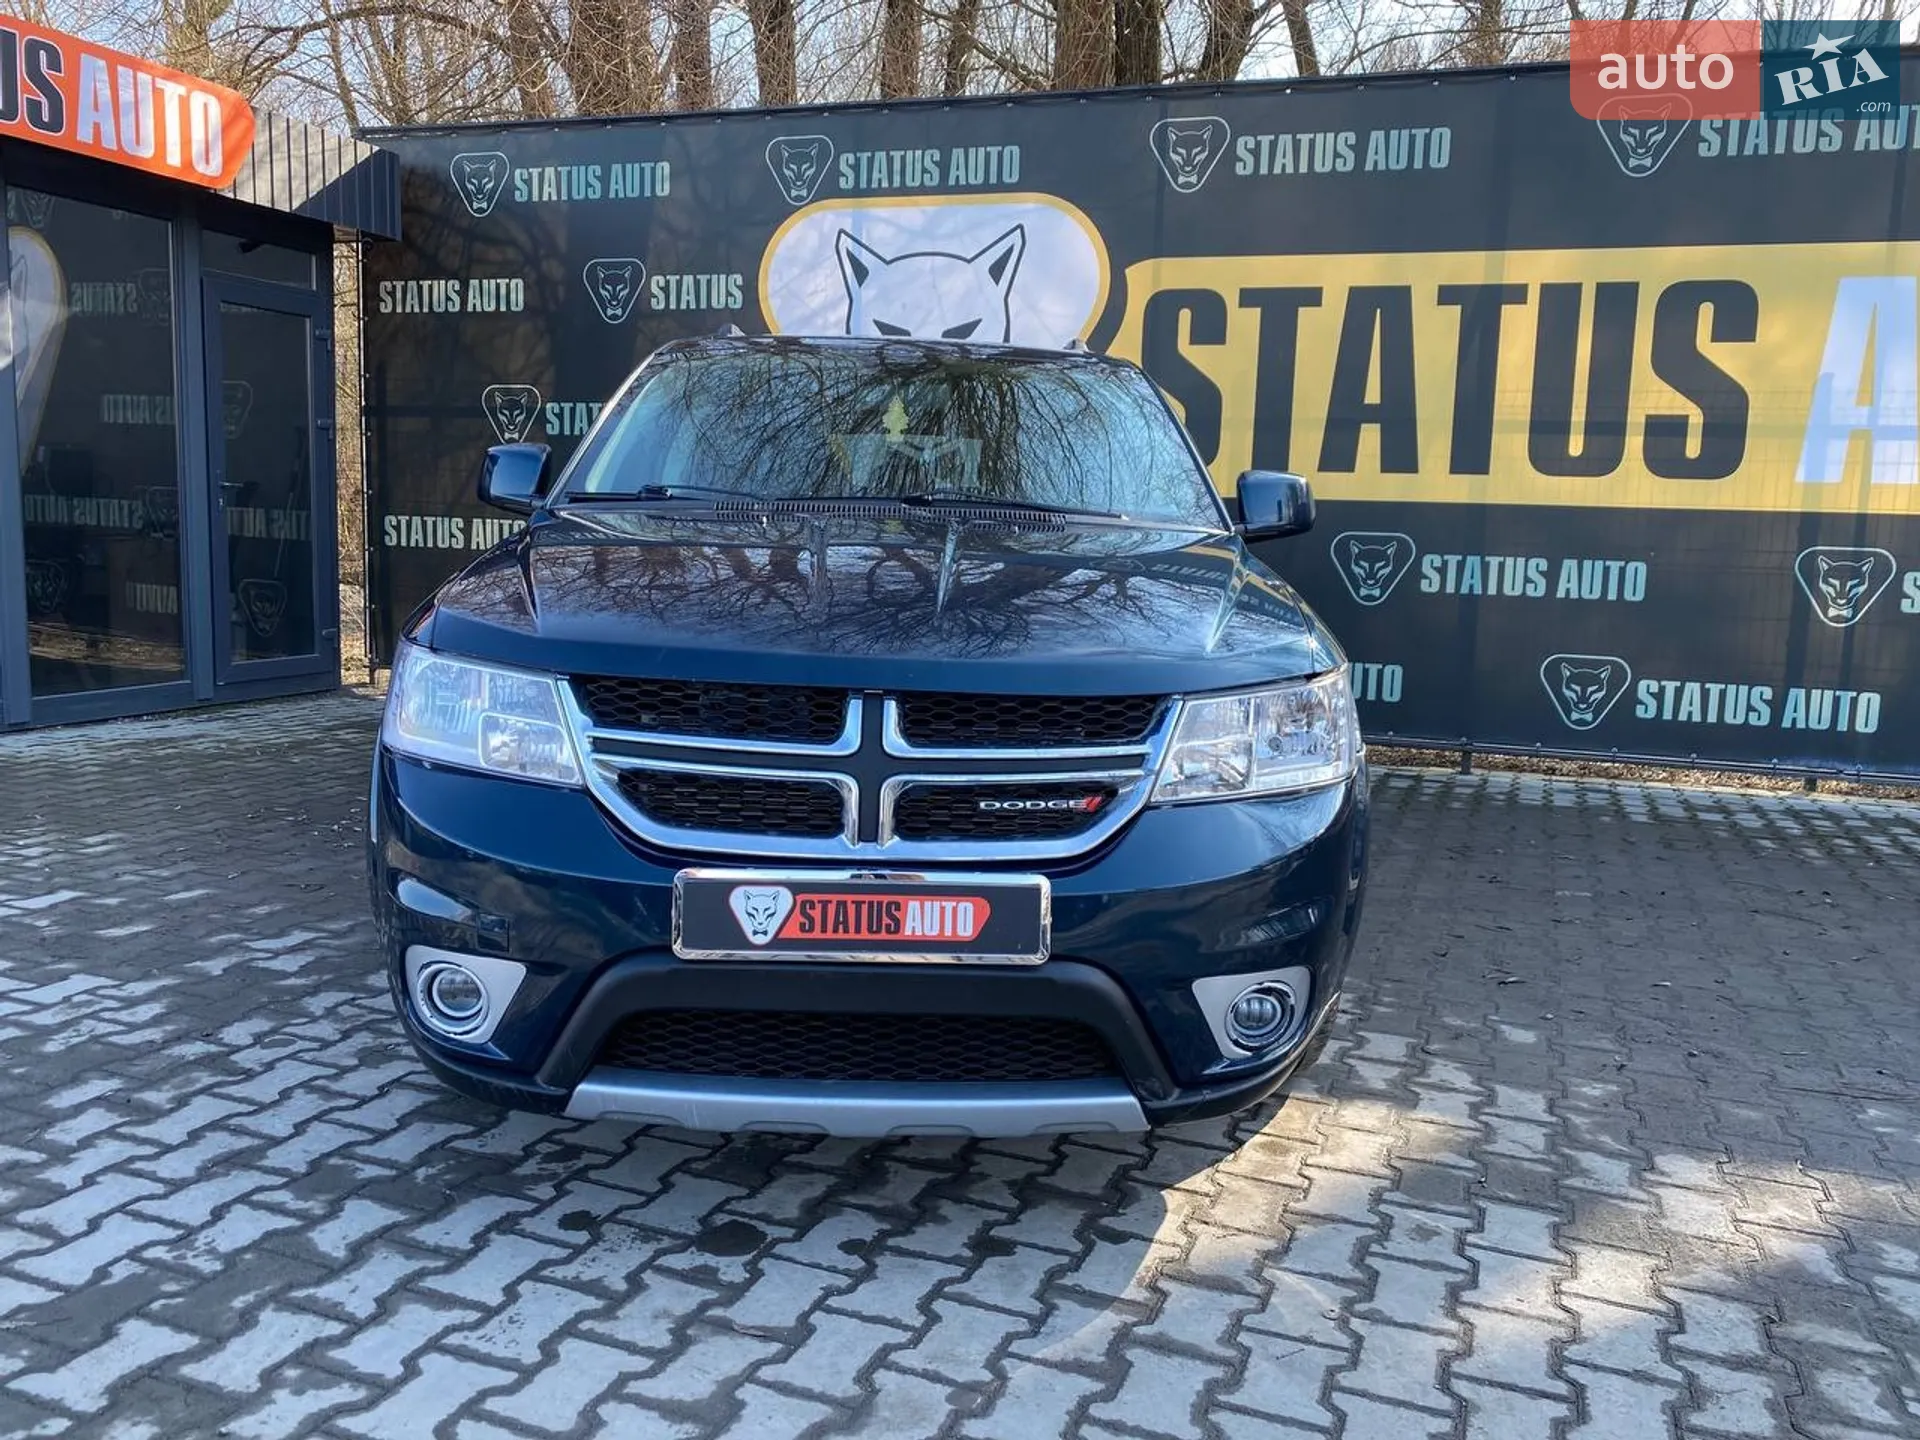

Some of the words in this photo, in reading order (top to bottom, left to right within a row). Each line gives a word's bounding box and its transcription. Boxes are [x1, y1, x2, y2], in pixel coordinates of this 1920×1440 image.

[76, 53, 223, 177] AUTO
[1698, 109, 1844, 157] STATUS
[839, 149, 941, 190] STATUS
[948, 145, 1020, 186] AUTO
[1235, 132, 1356, 176] STATUS
[1364, 127, 1451, 171] AUTO
[514, 163, 601, 202] STATUS
[609, 161, 671, 198] AUTO
[379, 279, 461, 314] STATUS
[467, 278, 525, 312] AUTO
[650, 273, 744, 310] STATUS
[1141, 279, 1759, 480] STATUS
[546, 402, 603, 435] STAT
[384, 515, 464, 549] STATUS
[1420, 553, 1546, 598] STATUS
[1555, 559, 1648, 602] AUTO
[1347, 662, 1403, 702] UTO
[1635, 679, 1772, 727] STATUS
[1781, 687, 1881, 734] AUTO
[980, 800, 1087, 810] DODGE
[799, 899, 902, 935] STATUS
[904, 900, 975, 937] AUTO
